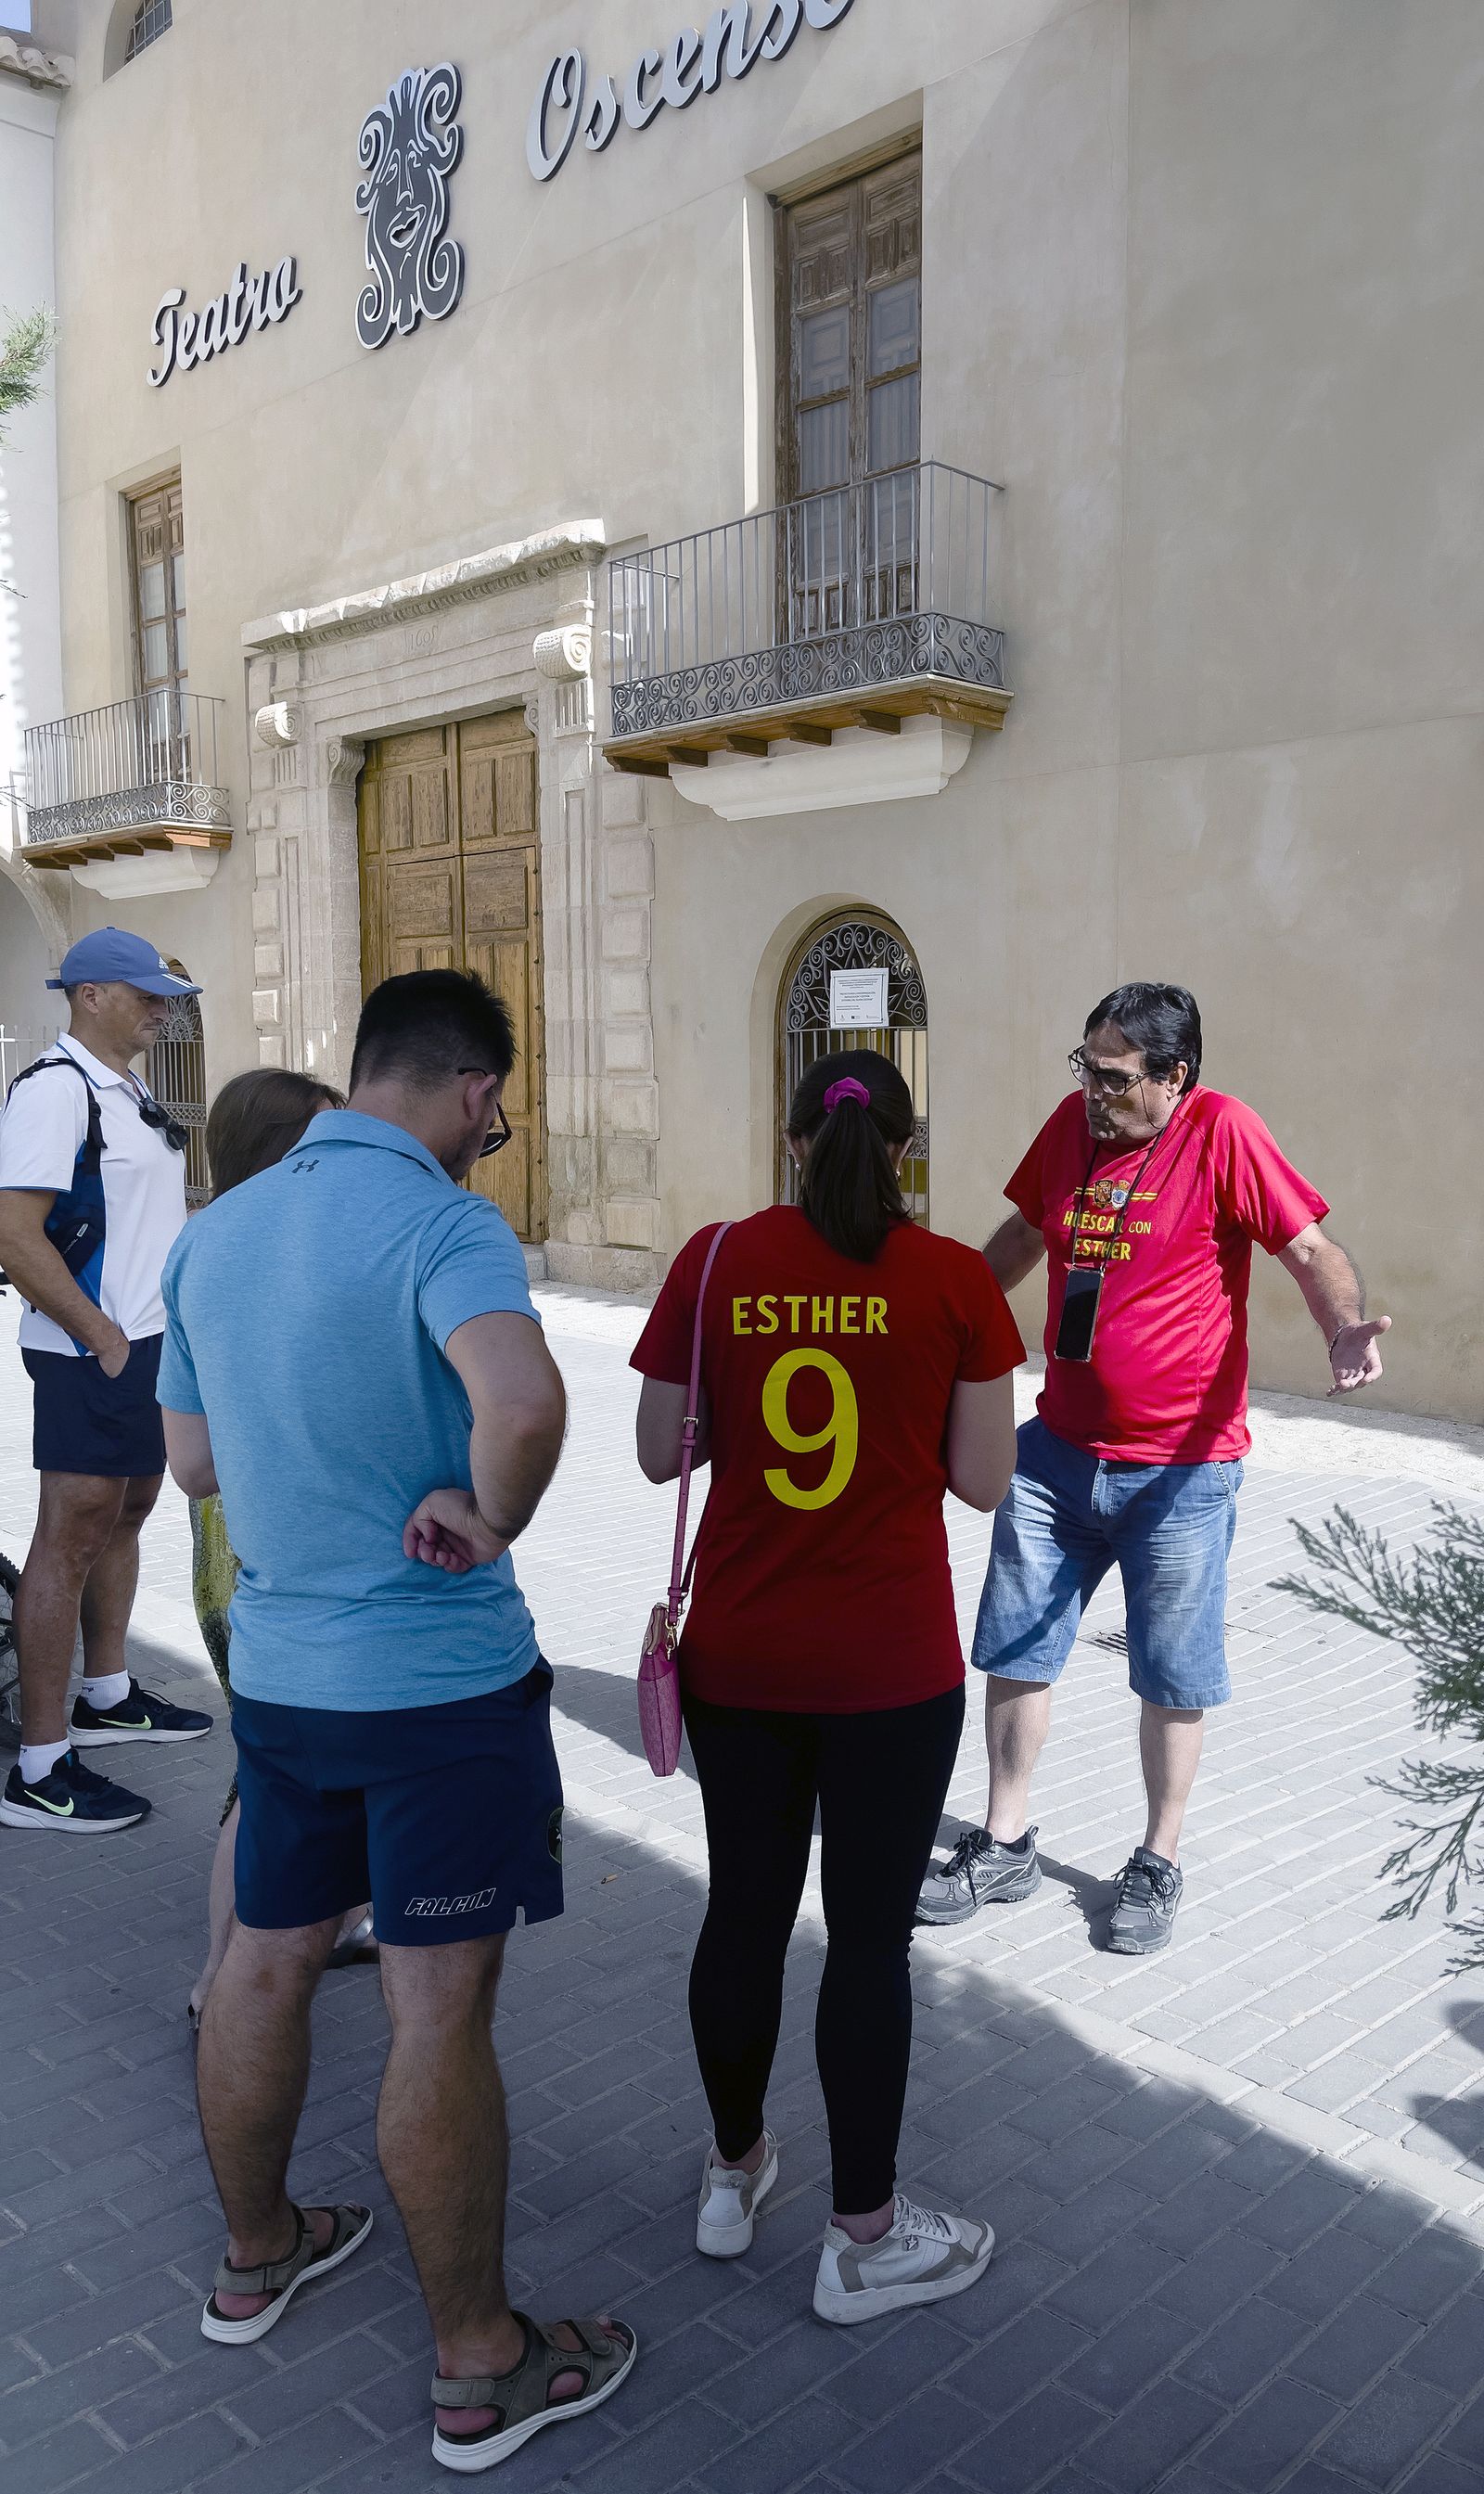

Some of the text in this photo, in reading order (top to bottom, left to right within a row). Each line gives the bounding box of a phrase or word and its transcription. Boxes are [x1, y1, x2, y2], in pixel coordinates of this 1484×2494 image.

[147, 255, 303, 388] Teatro
[1128, 1221, 1152, 1234] CON
[733, 1295, 889, 1335] ESTHER
[761, 1348, 859, 1510] 9
[404, 1887, 496, 1915] FALCON
